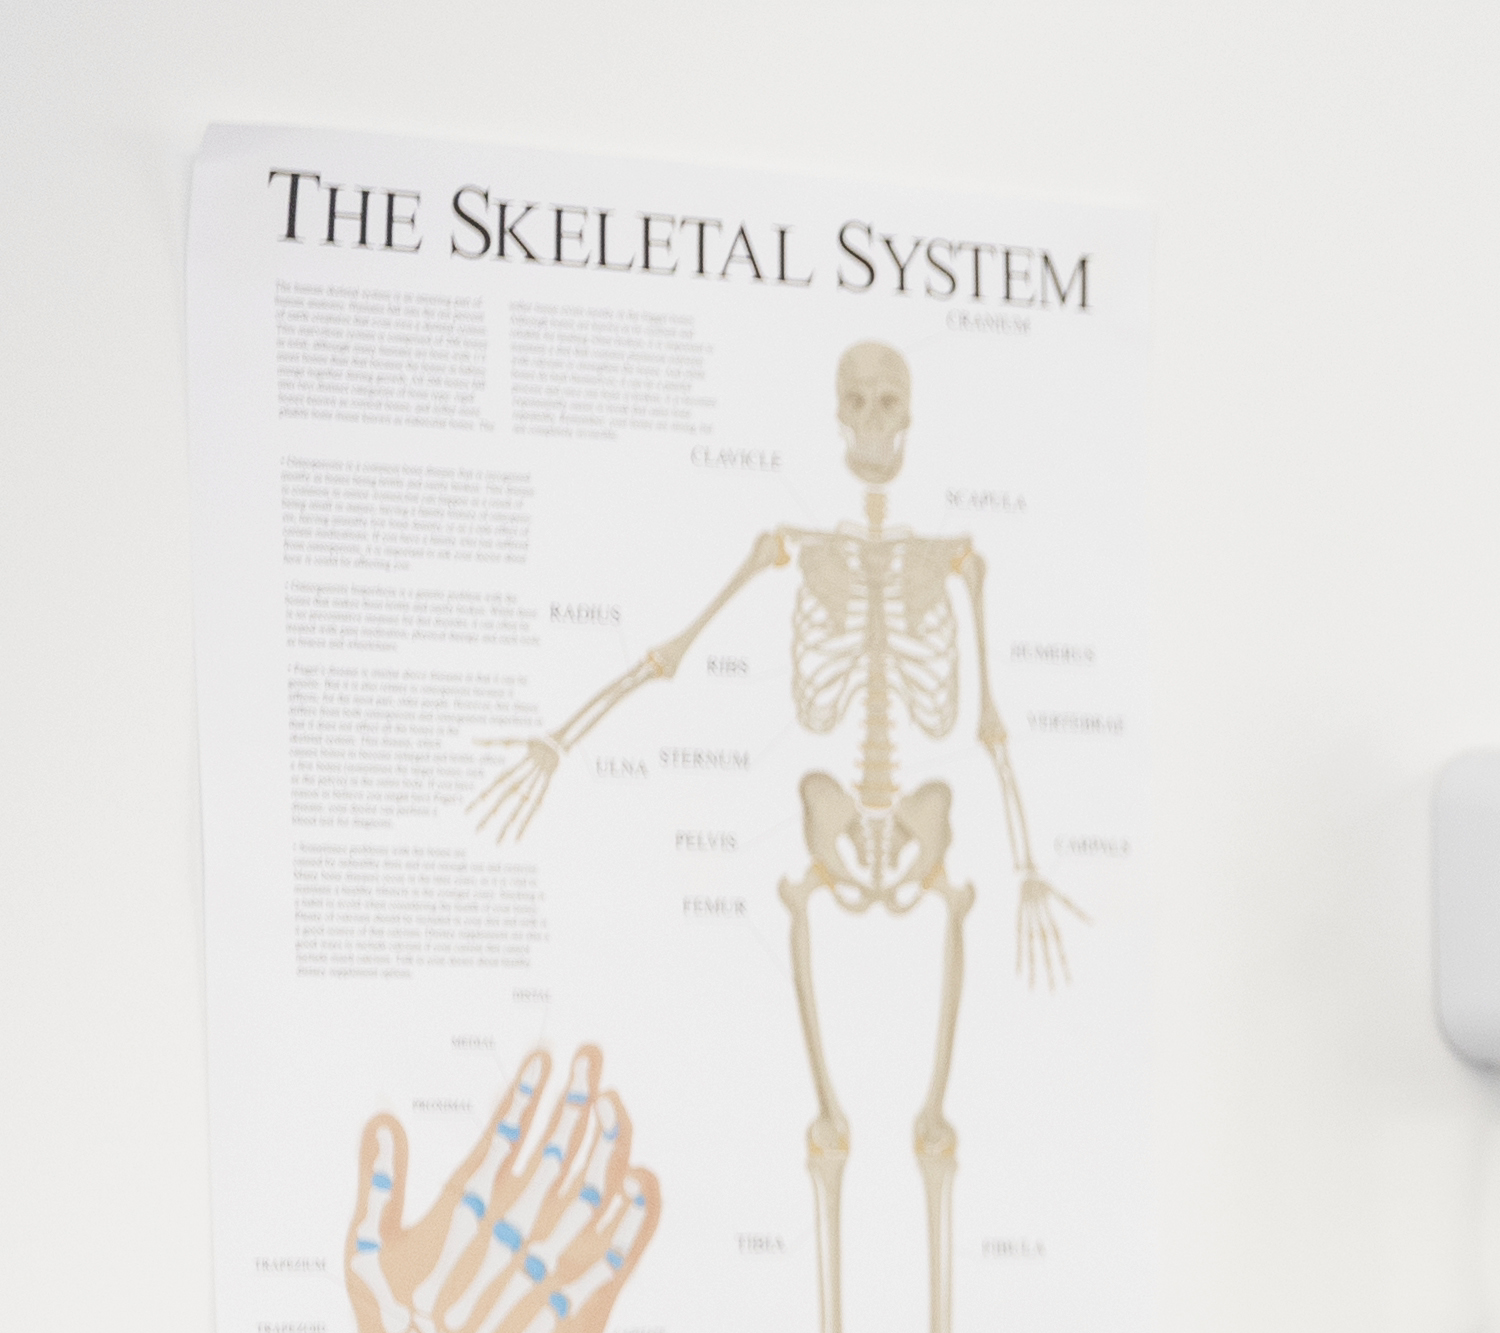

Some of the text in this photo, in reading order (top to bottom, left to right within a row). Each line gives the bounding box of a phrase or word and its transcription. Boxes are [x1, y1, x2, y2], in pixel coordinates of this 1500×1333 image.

[268, 169, 1092, 312] THE SKELETAL SYSTEM
[690, 447, 782, 472] CLAVICLE
[549, 603, 622, 625] RADIUS
[707, 656, 749, 676] RIBS
[595, 757, 648, 779] ULNA
[659, 748, 750, 770] STERNUM
[675, 830, 737, 851] PELVIS
[683, 897, 746, 917] FEMUR
